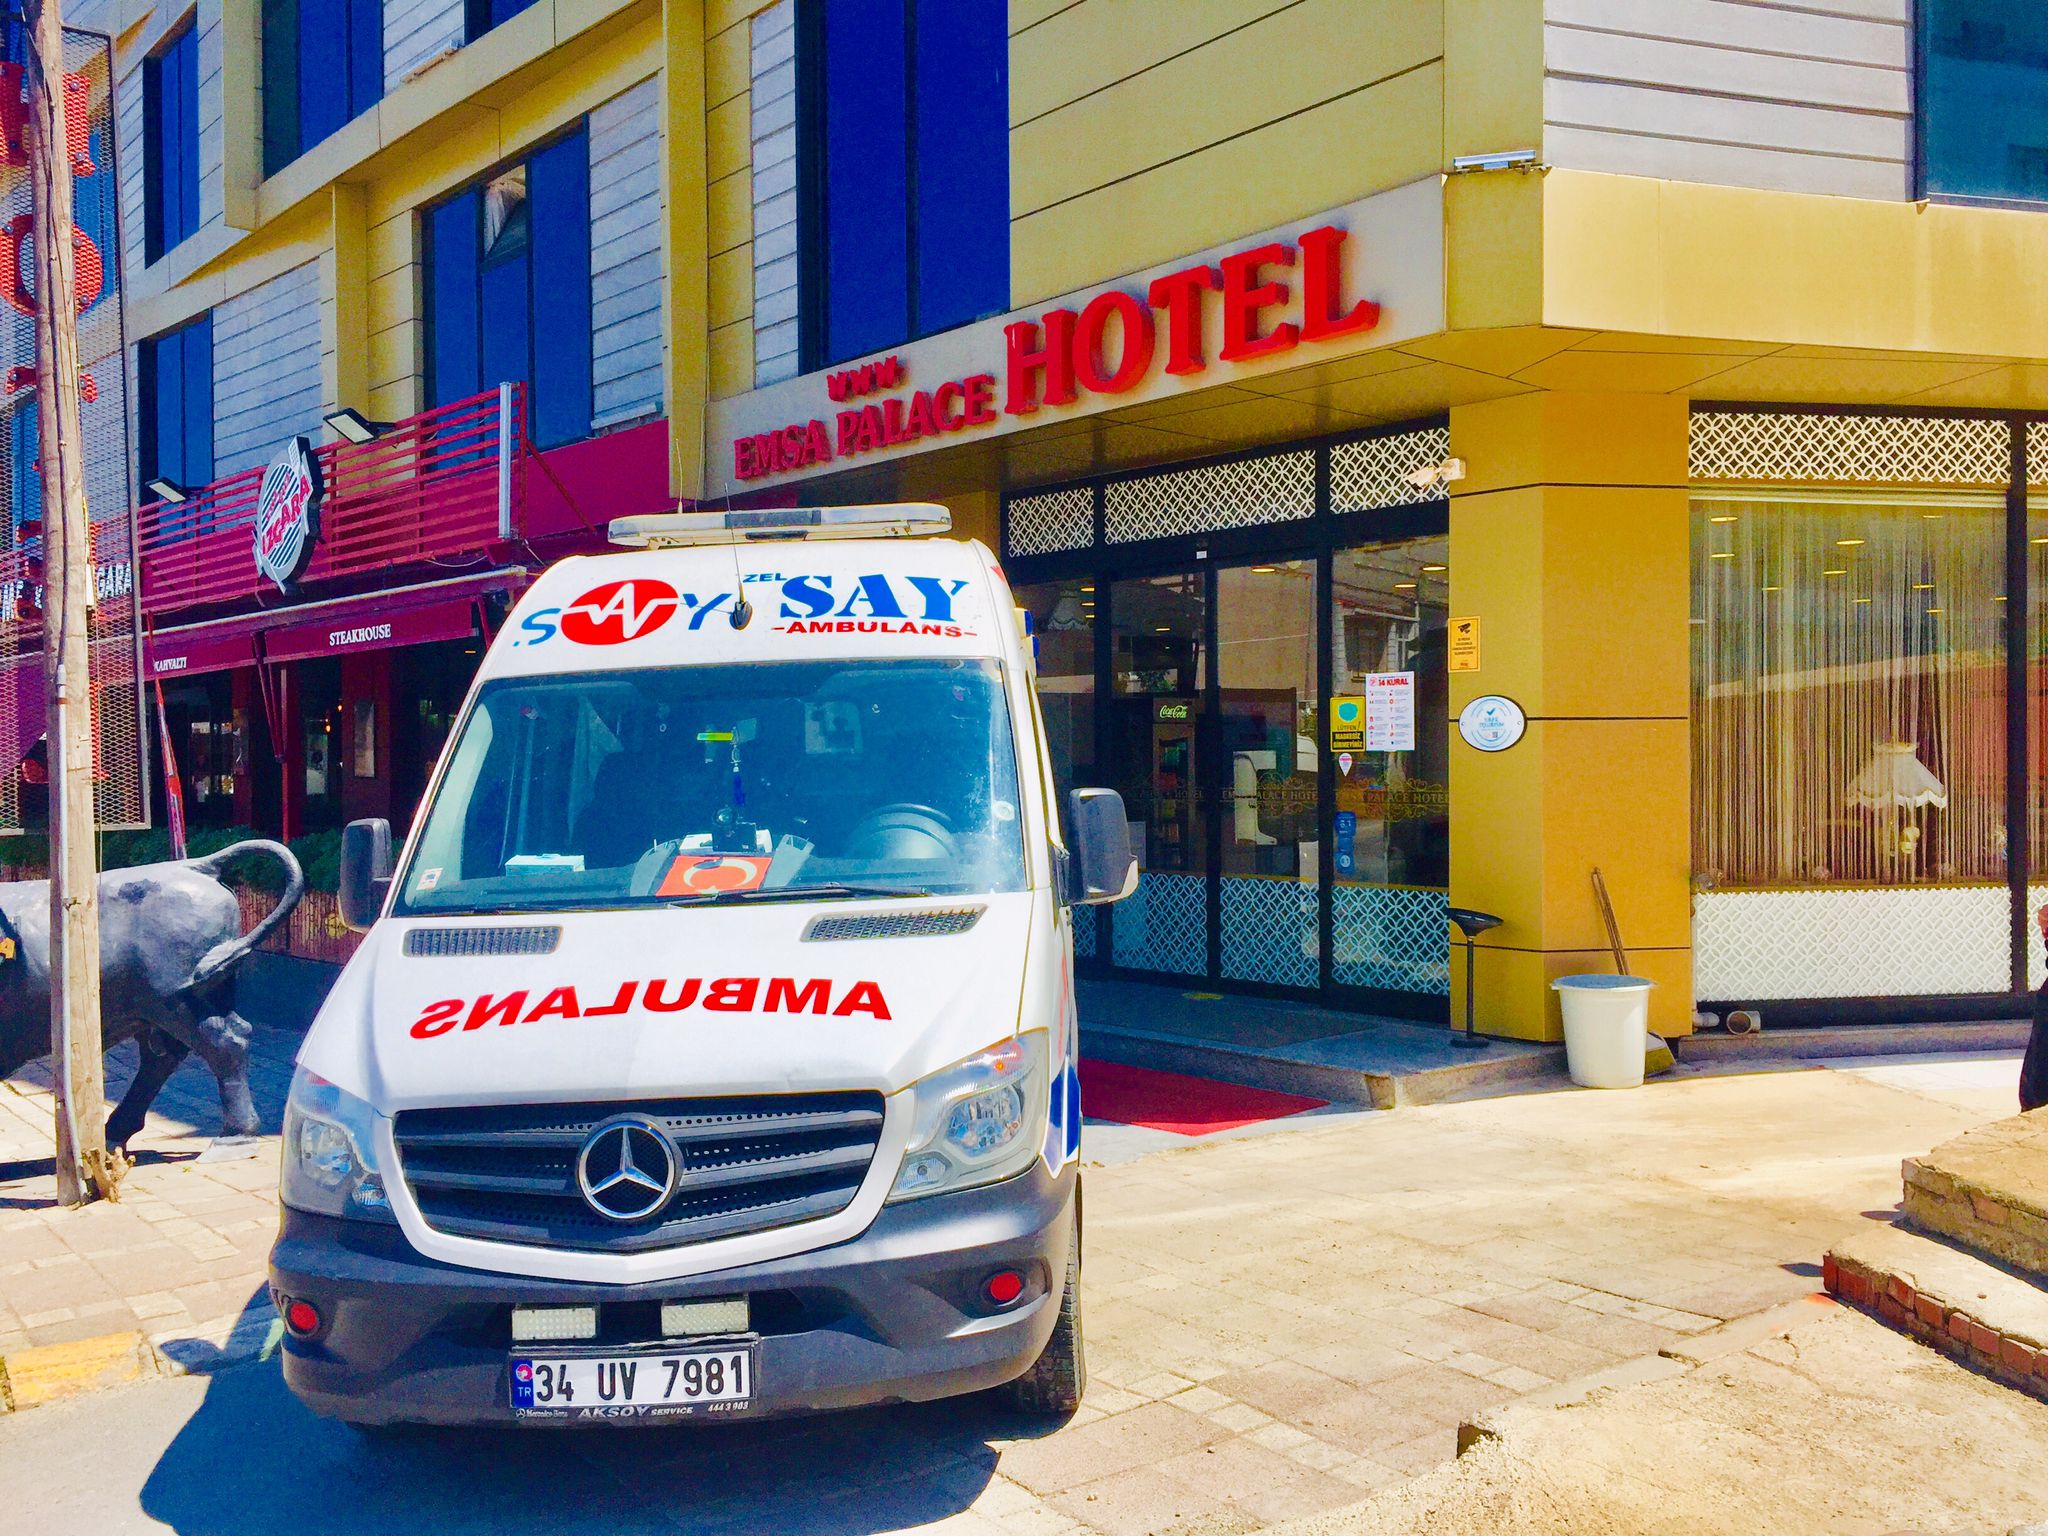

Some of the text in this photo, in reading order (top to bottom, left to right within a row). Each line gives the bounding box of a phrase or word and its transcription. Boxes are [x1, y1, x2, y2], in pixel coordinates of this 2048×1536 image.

[734, 225, 1380, 480] EMSA PALACE HOTEL
[779, 573, 970, 622] SAY
[328, 623, 391, 647] STEAKHOUSE
[1387, 678, 1409, 687] KURAL
[535, 1355, 743, 1402] 34 UV 7981
[518, 1386, 532, 1398] TR
[577, 1406, 694, 1419] AKSOY SERVICE
